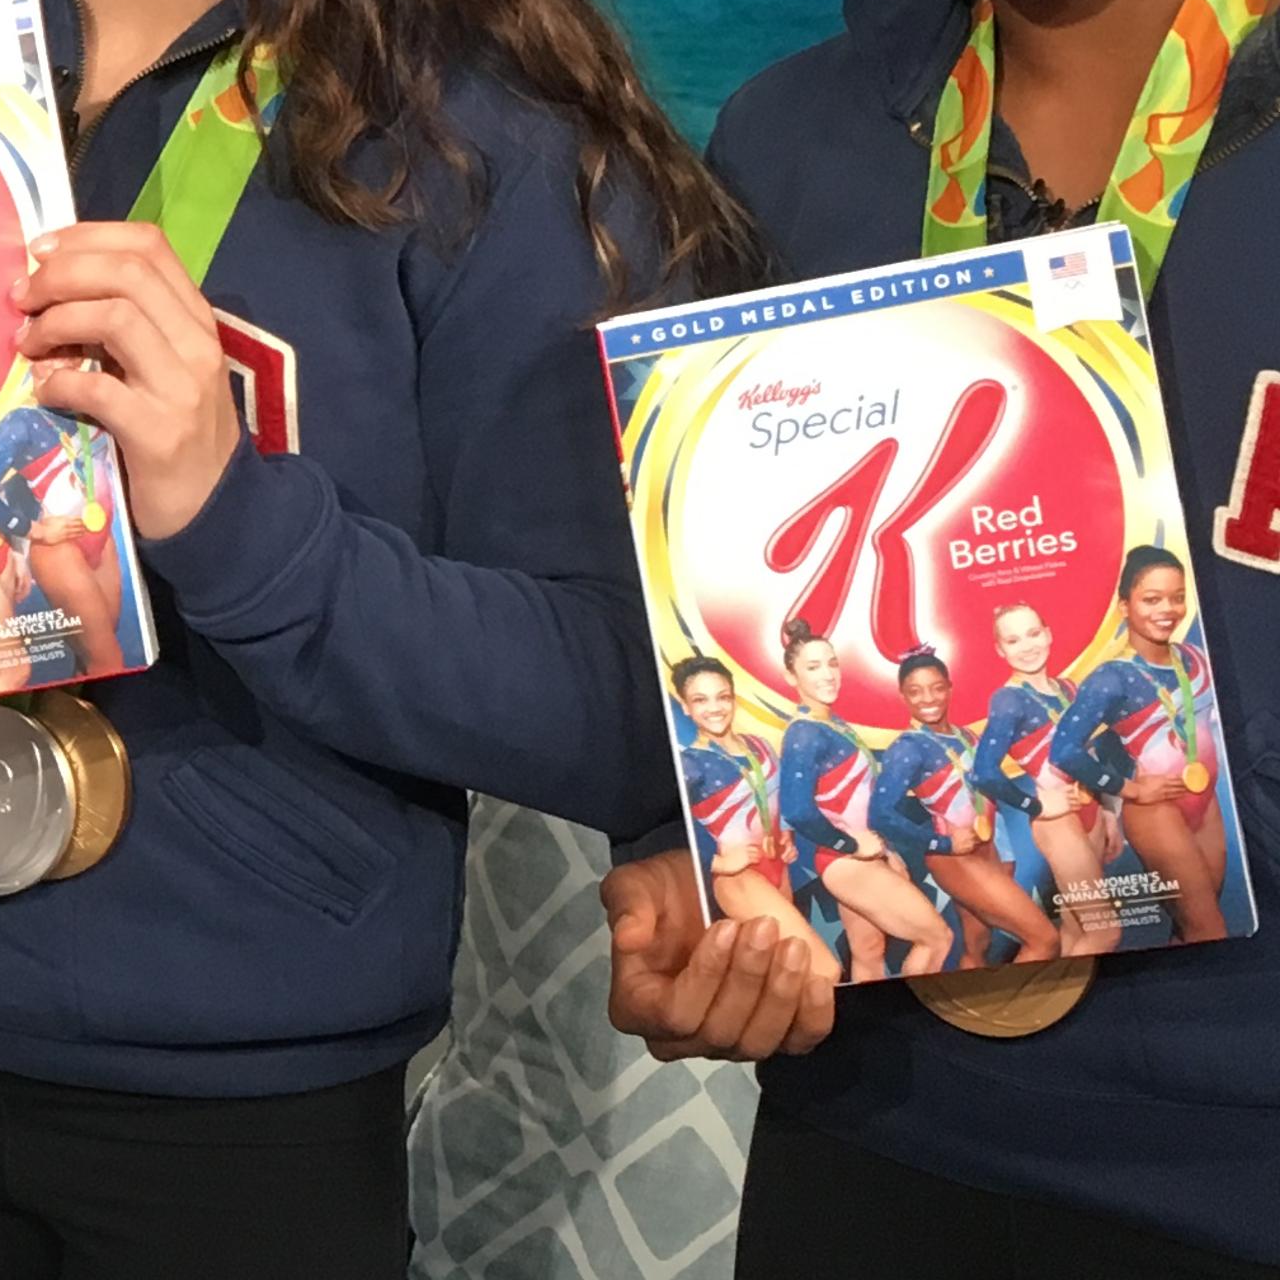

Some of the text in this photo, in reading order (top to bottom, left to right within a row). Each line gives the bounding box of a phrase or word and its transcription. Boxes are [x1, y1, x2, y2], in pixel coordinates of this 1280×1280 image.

[651, 269, 972, 343] GOLD MEDAL EDITION
[738, 378, 823, 411] Kellogg's
[749, 387, 900, 457] Special
[763, 378, 1007, 664] K
[971, 494, 1044, 536] Red
[948, 528, 1078, 570] Berries
[5, 608, 64, 626] WOMEN'S
[47, 616, 81, 630] TEAM
[1052, 880, 1179, 905] GYMNASTICS TEAM
[1067, 871, 1160, 893] U.S. WOMEN'S
